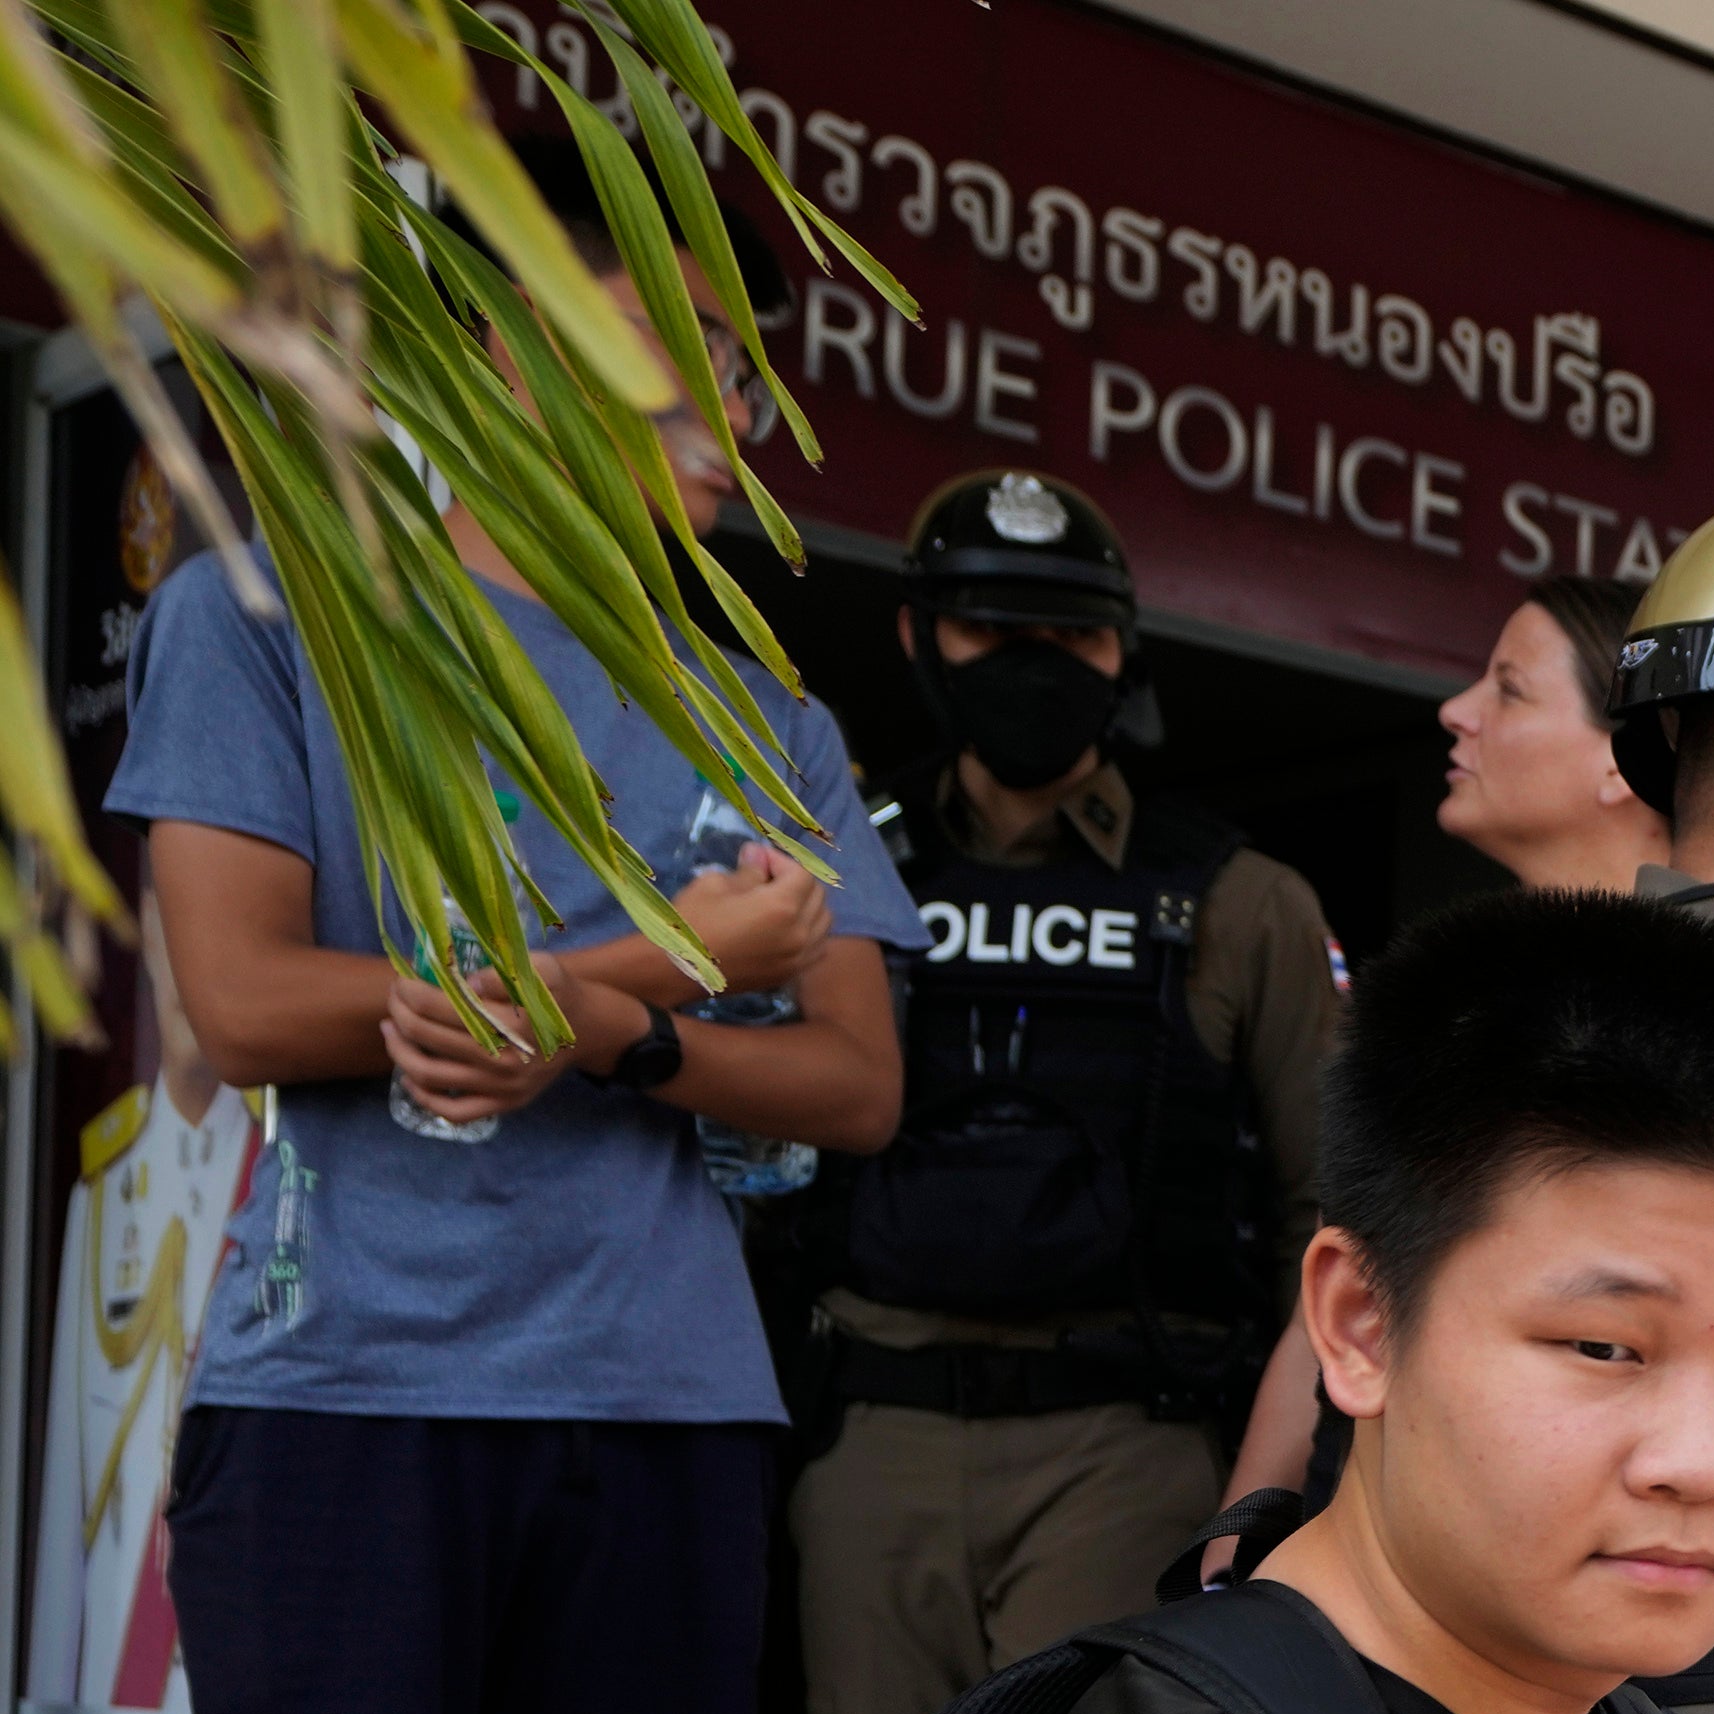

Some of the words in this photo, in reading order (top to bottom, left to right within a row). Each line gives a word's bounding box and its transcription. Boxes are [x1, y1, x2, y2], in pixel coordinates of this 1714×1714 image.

[762, 276, 1041, 444] RUE
[1090, 358, 1468, 558] POLICE
[1497, 480, 1691, 584] STA
[917, 899, 1138, 970] OLICE
